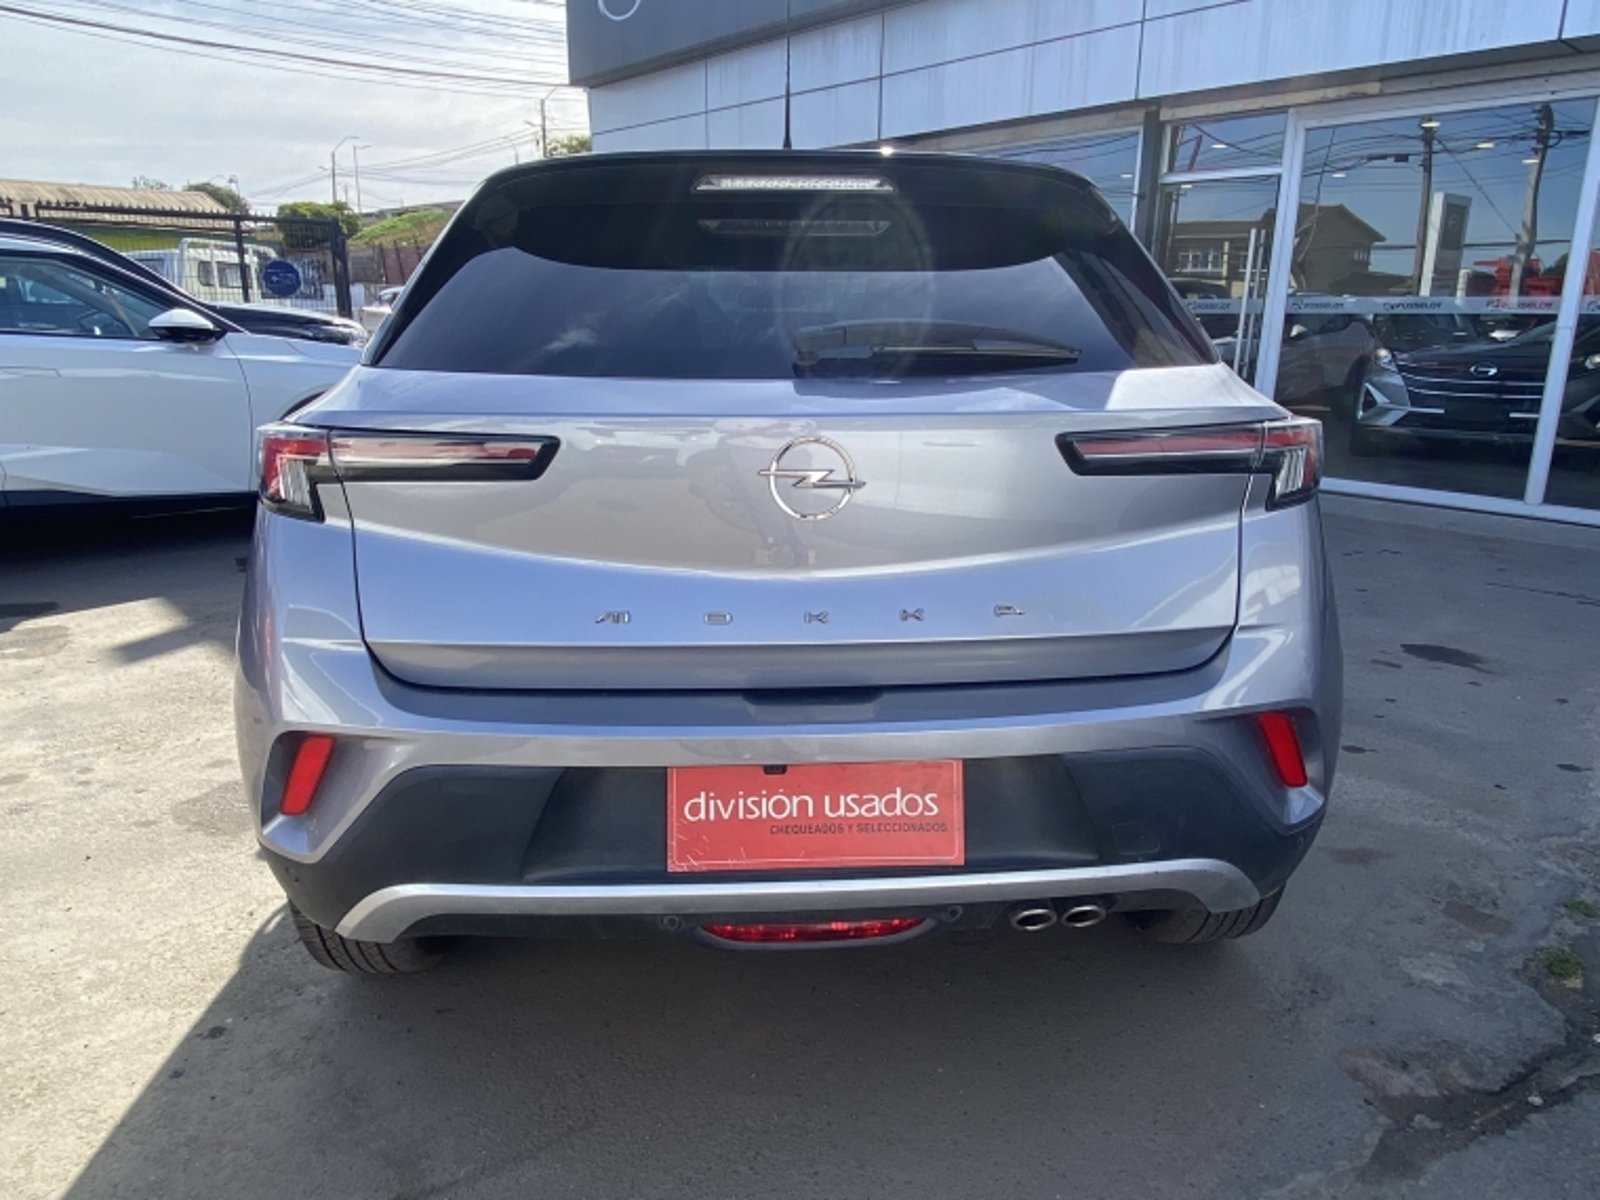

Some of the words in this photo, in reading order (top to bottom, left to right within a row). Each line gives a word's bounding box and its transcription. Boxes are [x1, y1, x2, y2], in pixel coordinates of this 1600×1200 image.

[594, 604, 1025, 625] MOKKA
[683, 789, 814, 822] división
[824, 787, 939, 818] usados
[769, 824, 844, 835] CHEQUEADOS
[848, 824, 854, 834] Y
[857, 822, 948, 834] SELECCIONADOS
